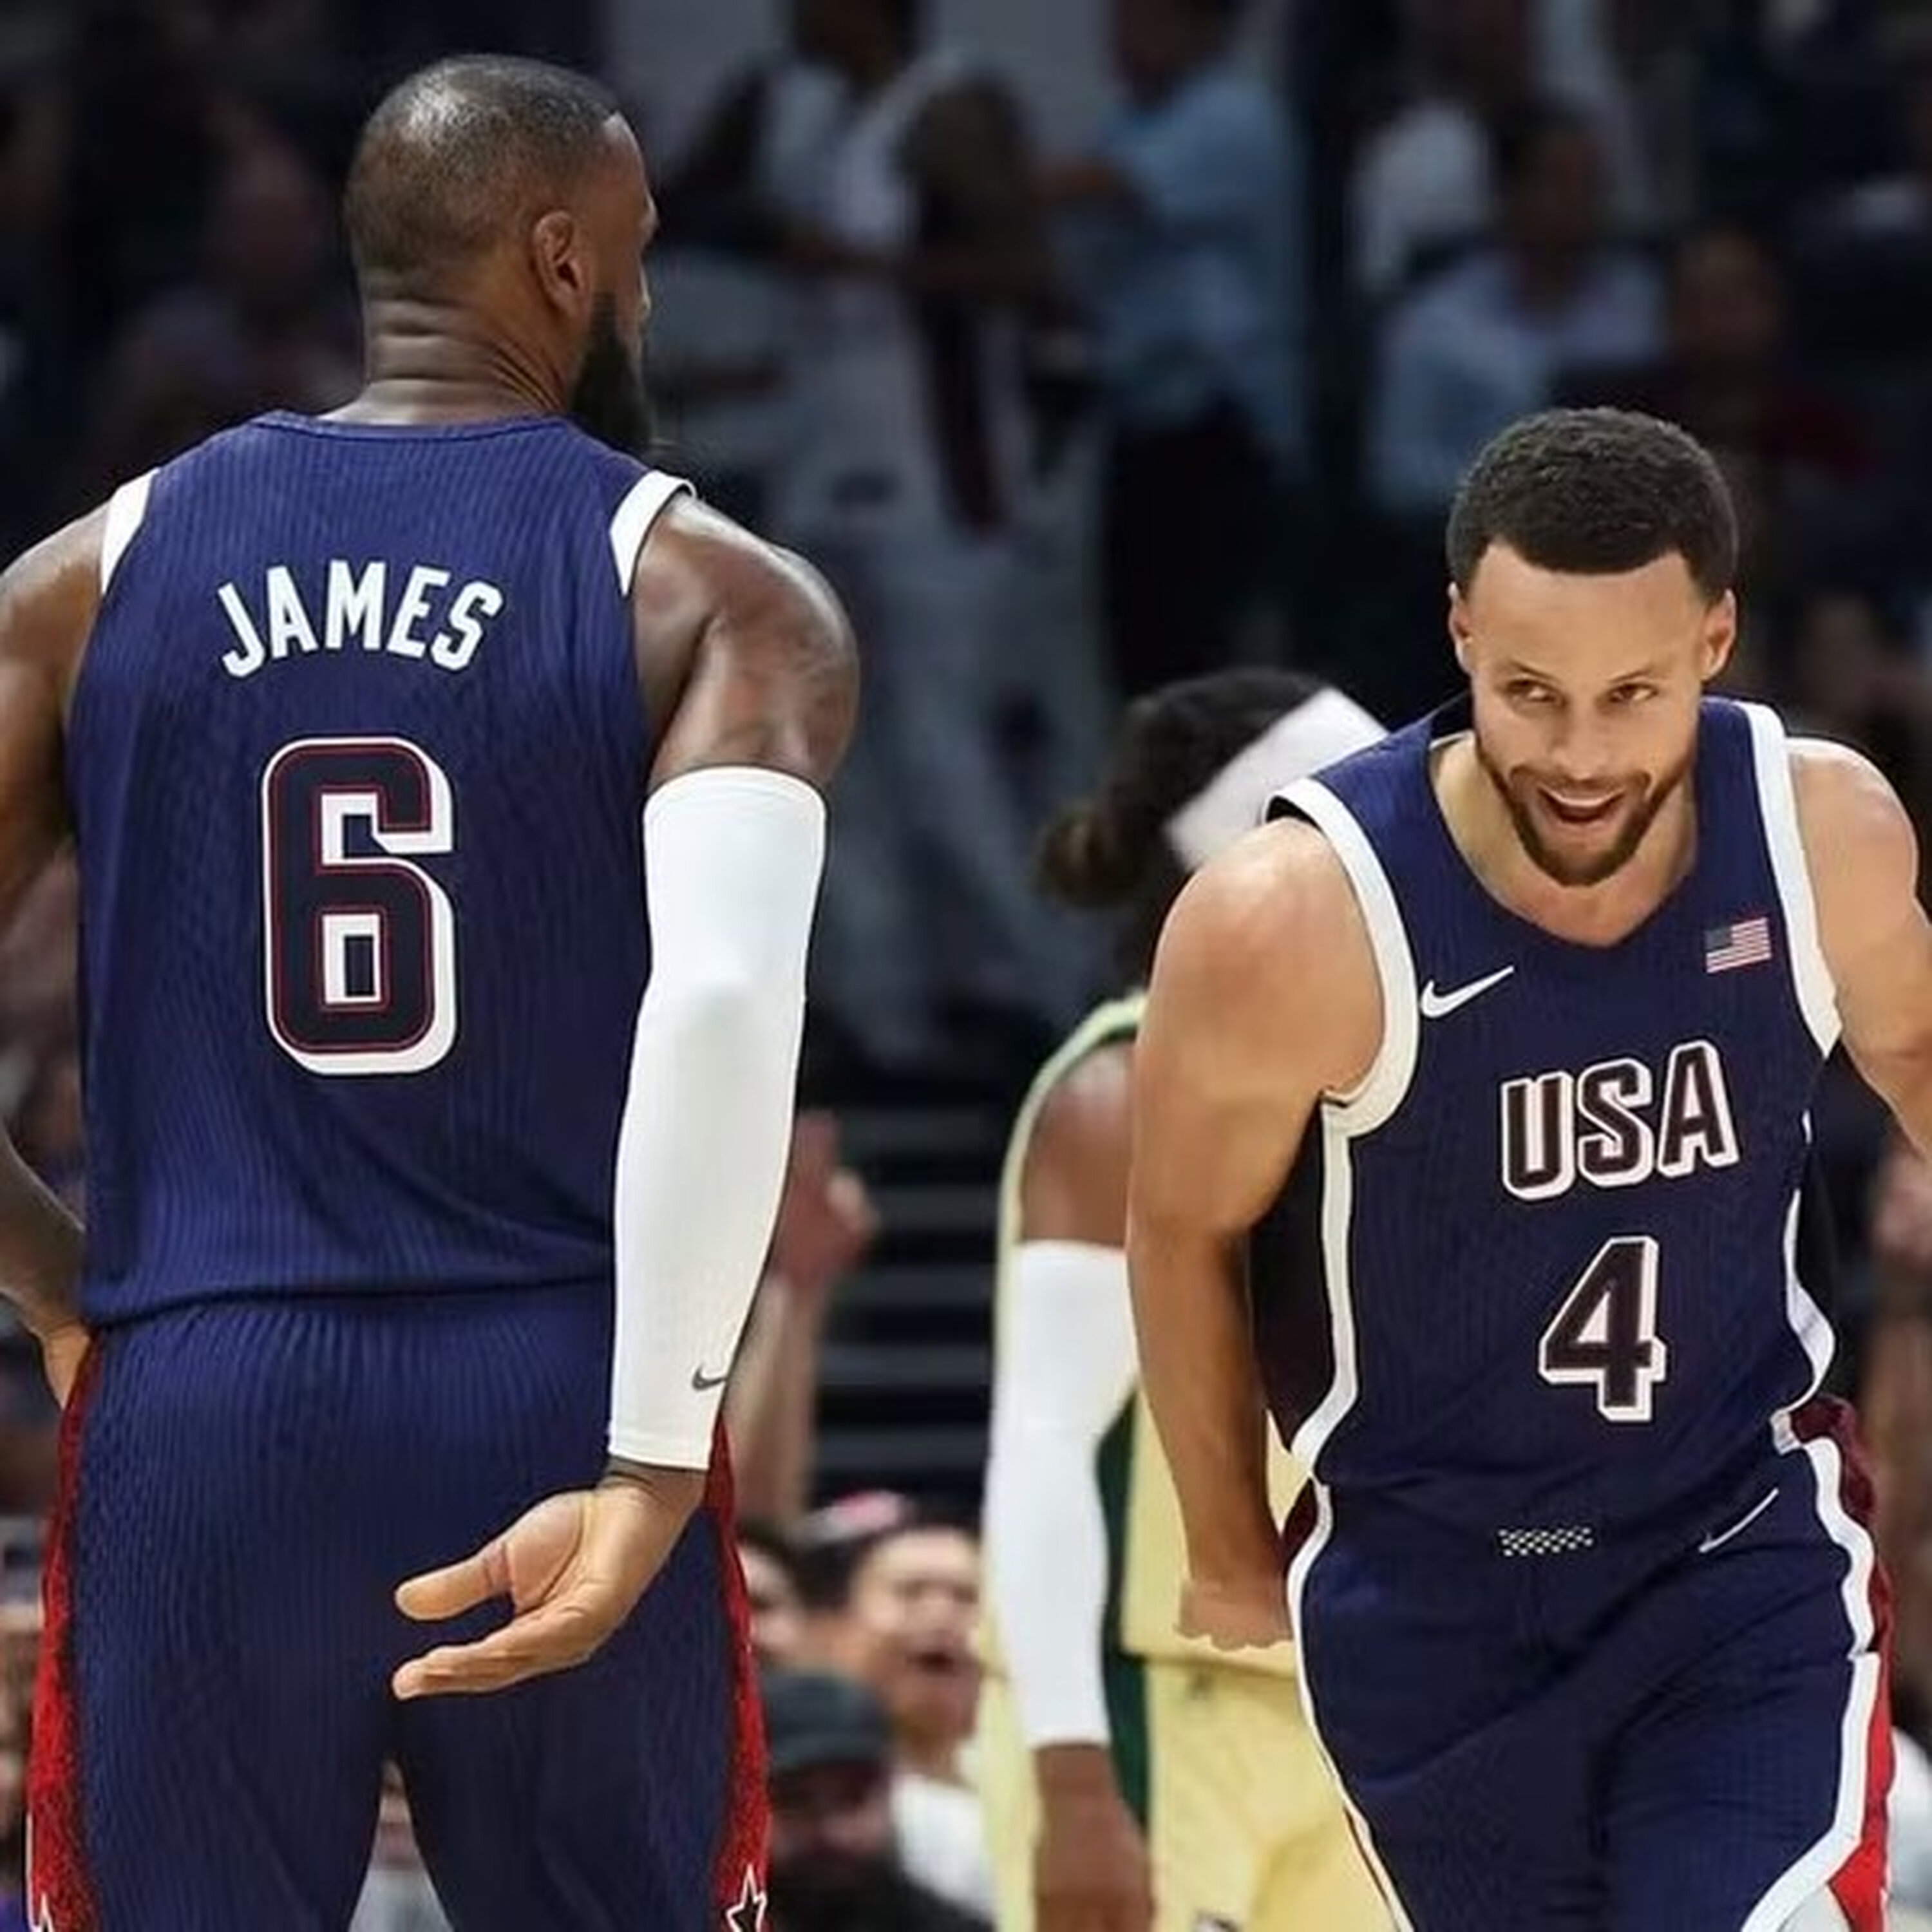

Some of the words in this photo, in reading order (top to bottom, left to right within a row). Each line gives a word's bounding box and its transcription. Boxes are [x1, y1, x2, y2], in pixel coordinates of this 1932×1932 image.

[218, 560, 503, 677] JAMES
[263, 737, 457, 1075] 6
[1501, 1041, 1739, 1200] USA
[1539, 1236, 1666, 1422] 4
